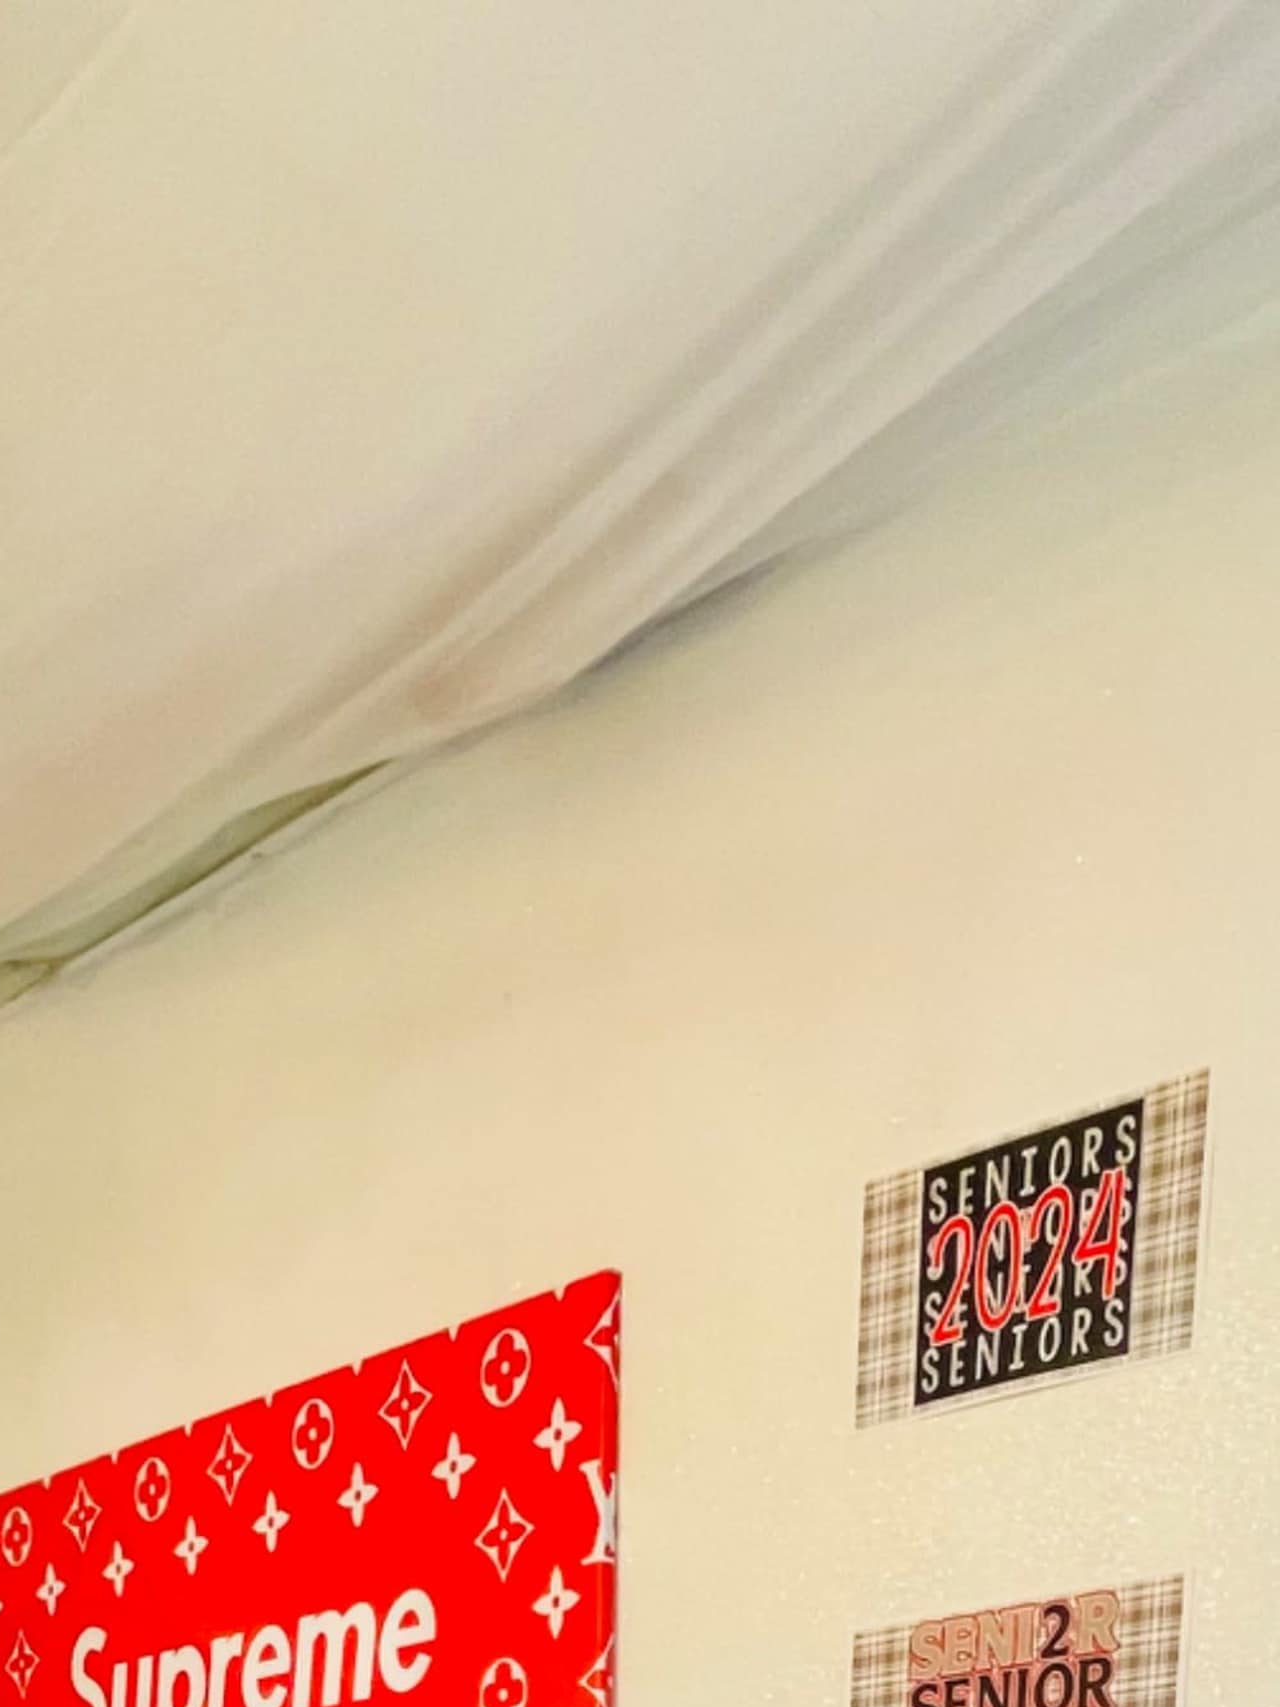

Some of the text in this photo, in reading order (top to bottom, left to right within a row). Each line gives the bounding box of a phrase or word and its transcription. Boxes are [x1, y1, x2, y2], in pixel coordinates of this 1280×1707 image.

[927, 1114, 1138, 1225] SENIORS
[929, 1167, 1127, 1348] 2024
[920, 1299, 1126, 1394] SENIORS
